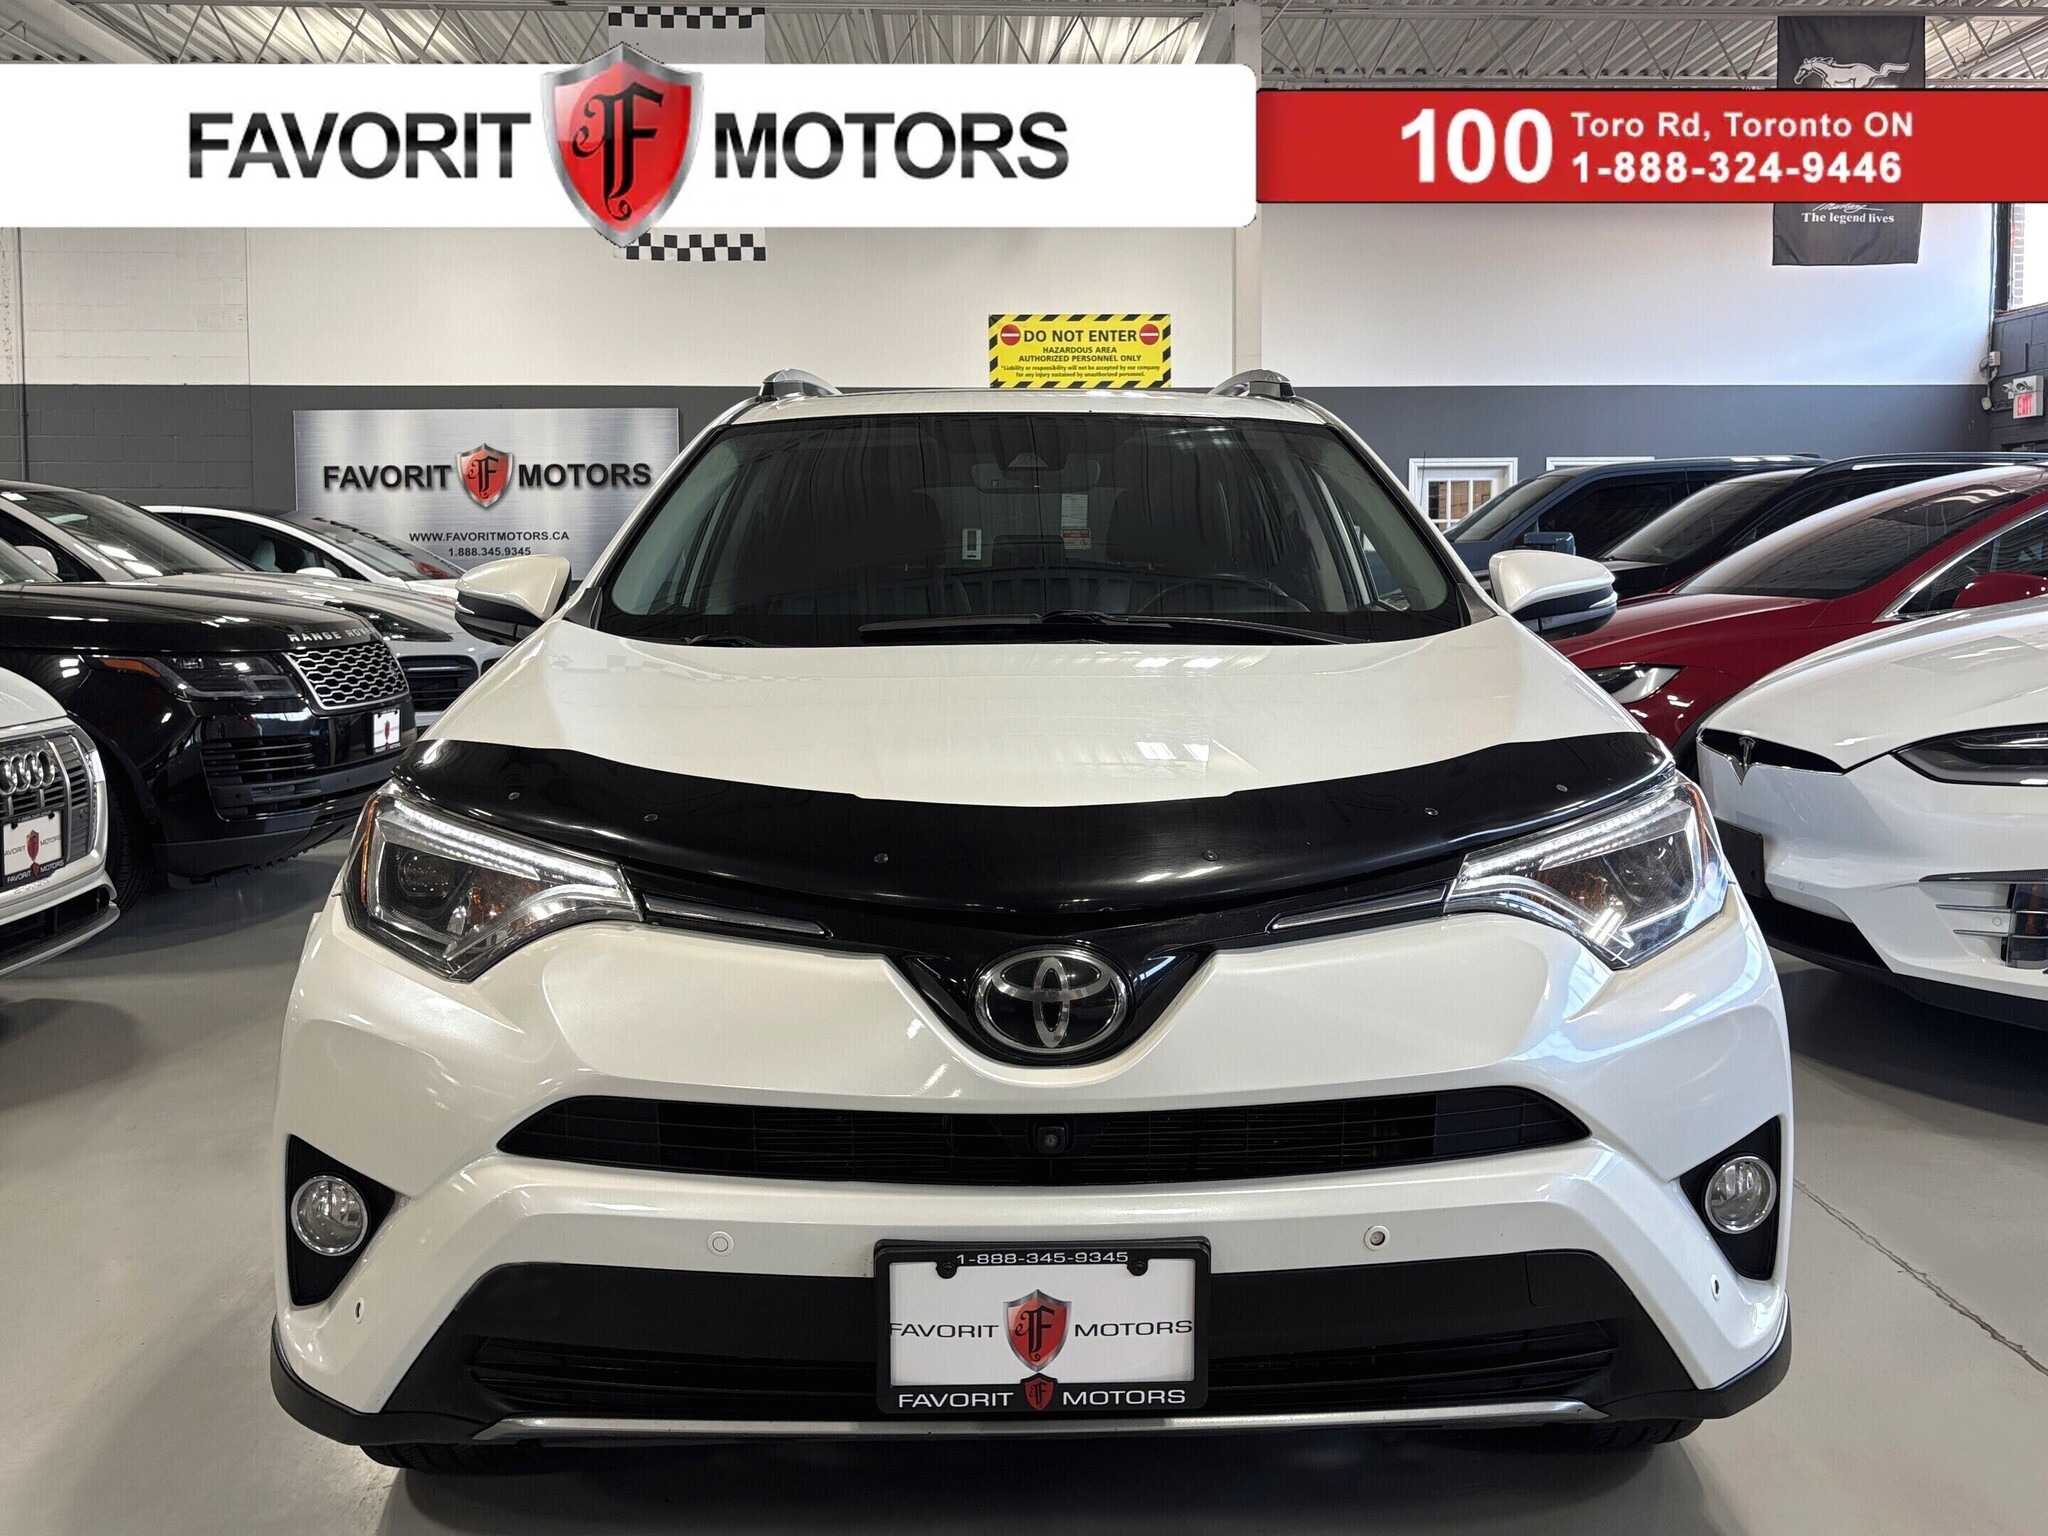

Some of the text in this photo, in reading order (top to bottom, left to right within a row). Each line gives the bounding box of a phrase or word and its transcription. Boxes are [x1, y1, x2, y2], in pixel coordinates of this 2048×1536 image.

[1801, 212, 1895, 225] The legend lives
[1024, 330, 1137, 342] DO NOT ENTER
[323, 465, 452, 488] FAVORIT
[518, 463, 651, 488] MOTORS
[409, 531, 570, 542] WWW.FAVORITMOTORS.CA
[448, 546, 531, 557] 1.888.345.9345
[287, 631, 342, 642] RANGE
[4, 845, 26, 857] AVORIT
[7, 860, 65, 883] FAVORIT MOTORS
[956, 1252, 1129, 1265] 1-888-345-9345
[890, 1322, 1000, 1339] FAVORIT
[1074, 1320, 1194, 1337] MOTORS
[898, 1392, 1014, 1408] FAVORIT
[1063, 1390, 1187, 1406] MOTORS
